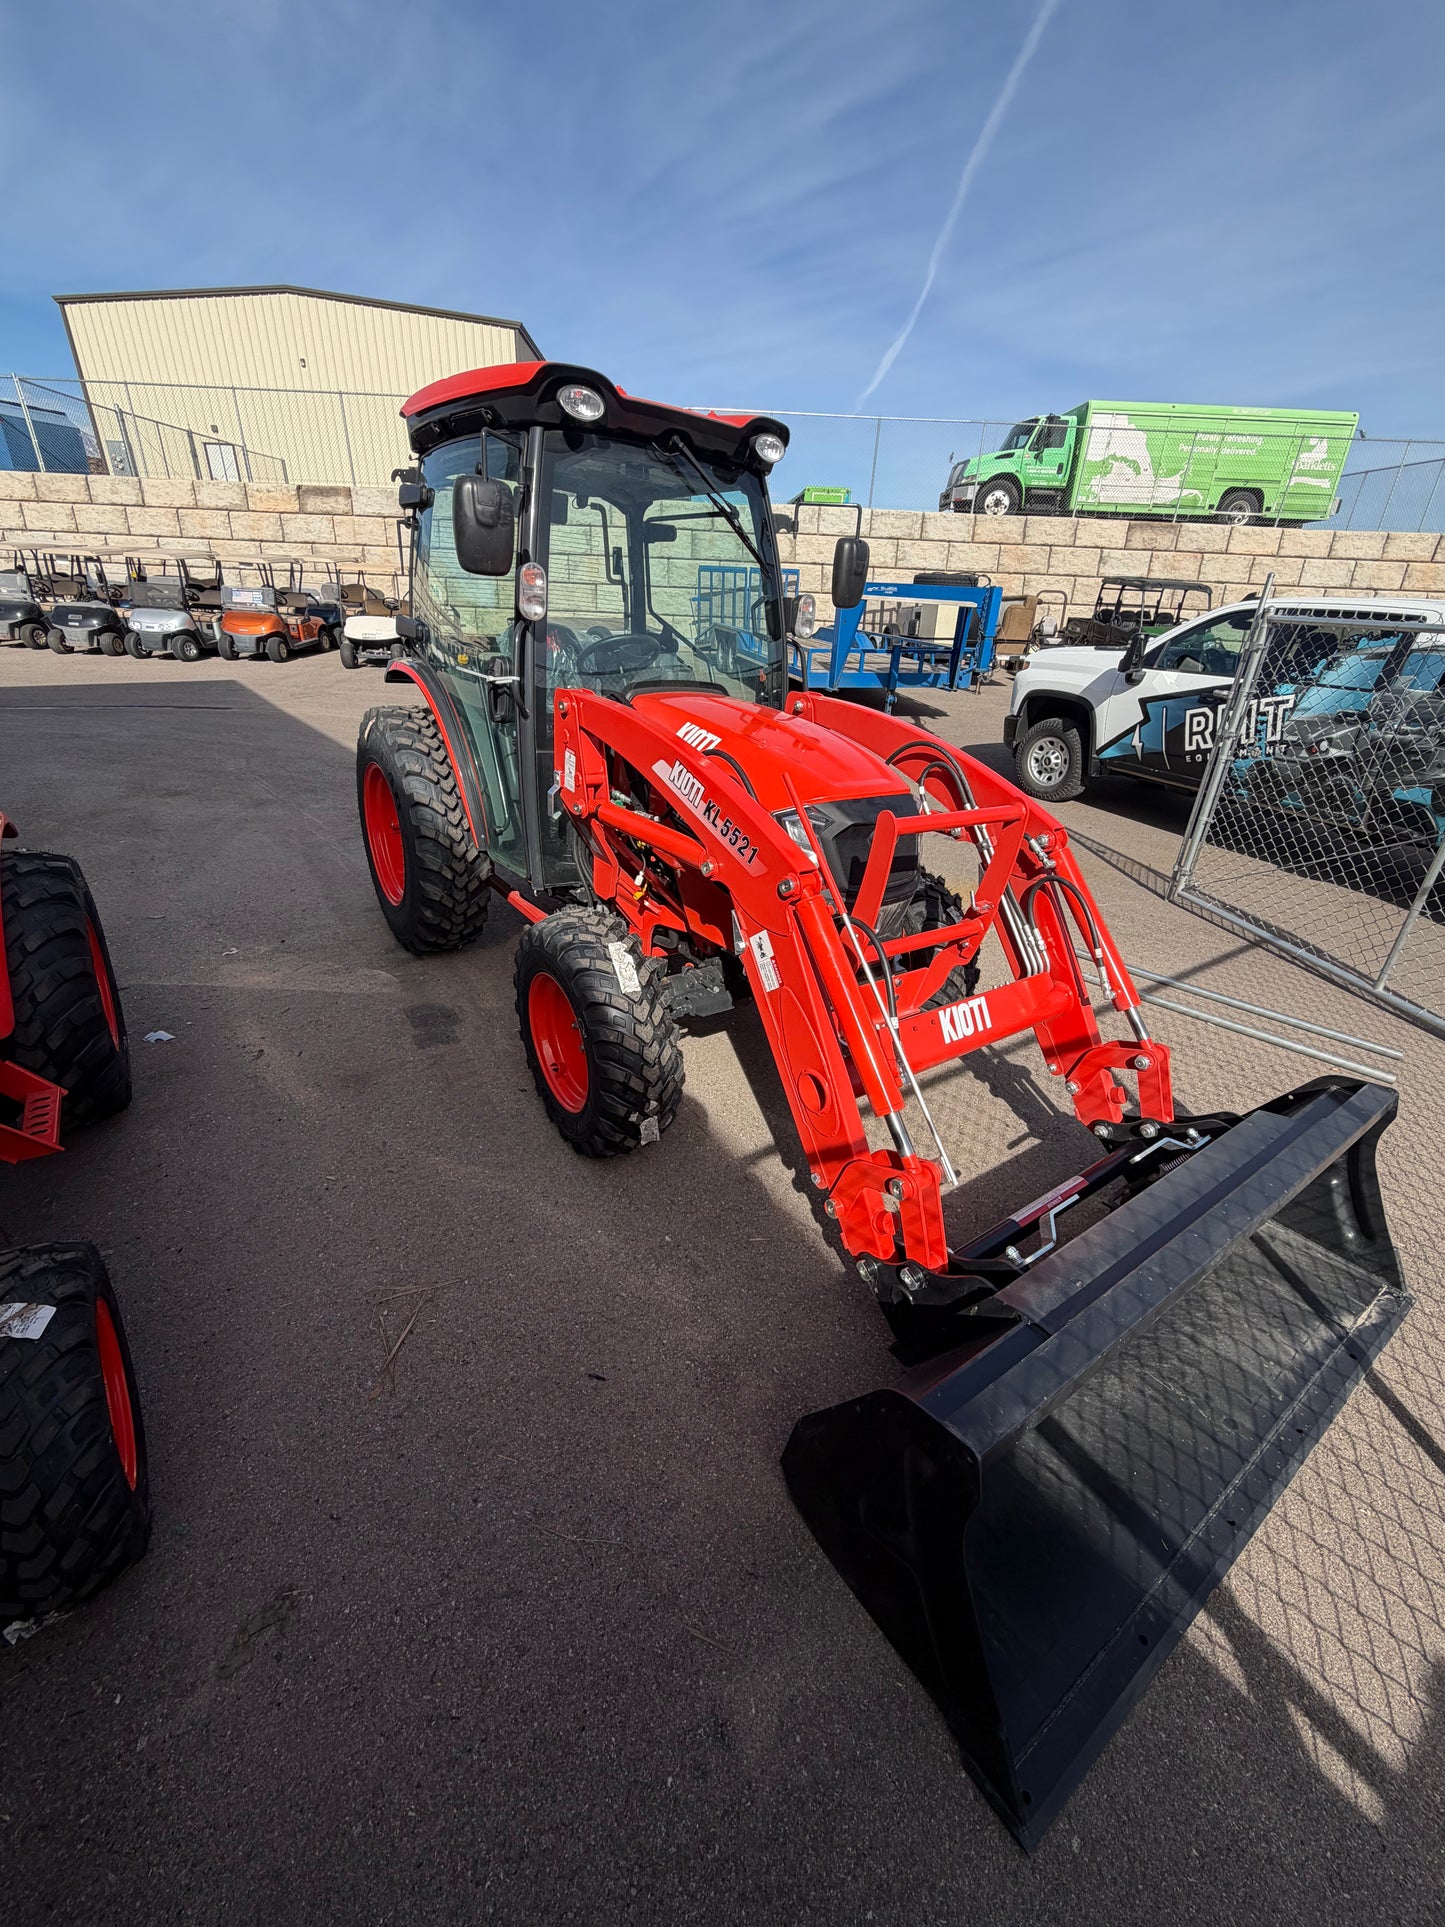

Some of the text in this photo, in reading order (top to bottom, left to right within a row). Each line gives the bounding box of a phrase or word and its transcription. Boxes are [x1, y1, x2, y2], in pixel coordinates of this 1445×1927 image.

[676, 721, 722, 751] KIOTI
[669, 759, 706, 809] KIOTI
[703, 799, 759, 865] KL5521
[938, 996, 992, 1045] KIOTI
